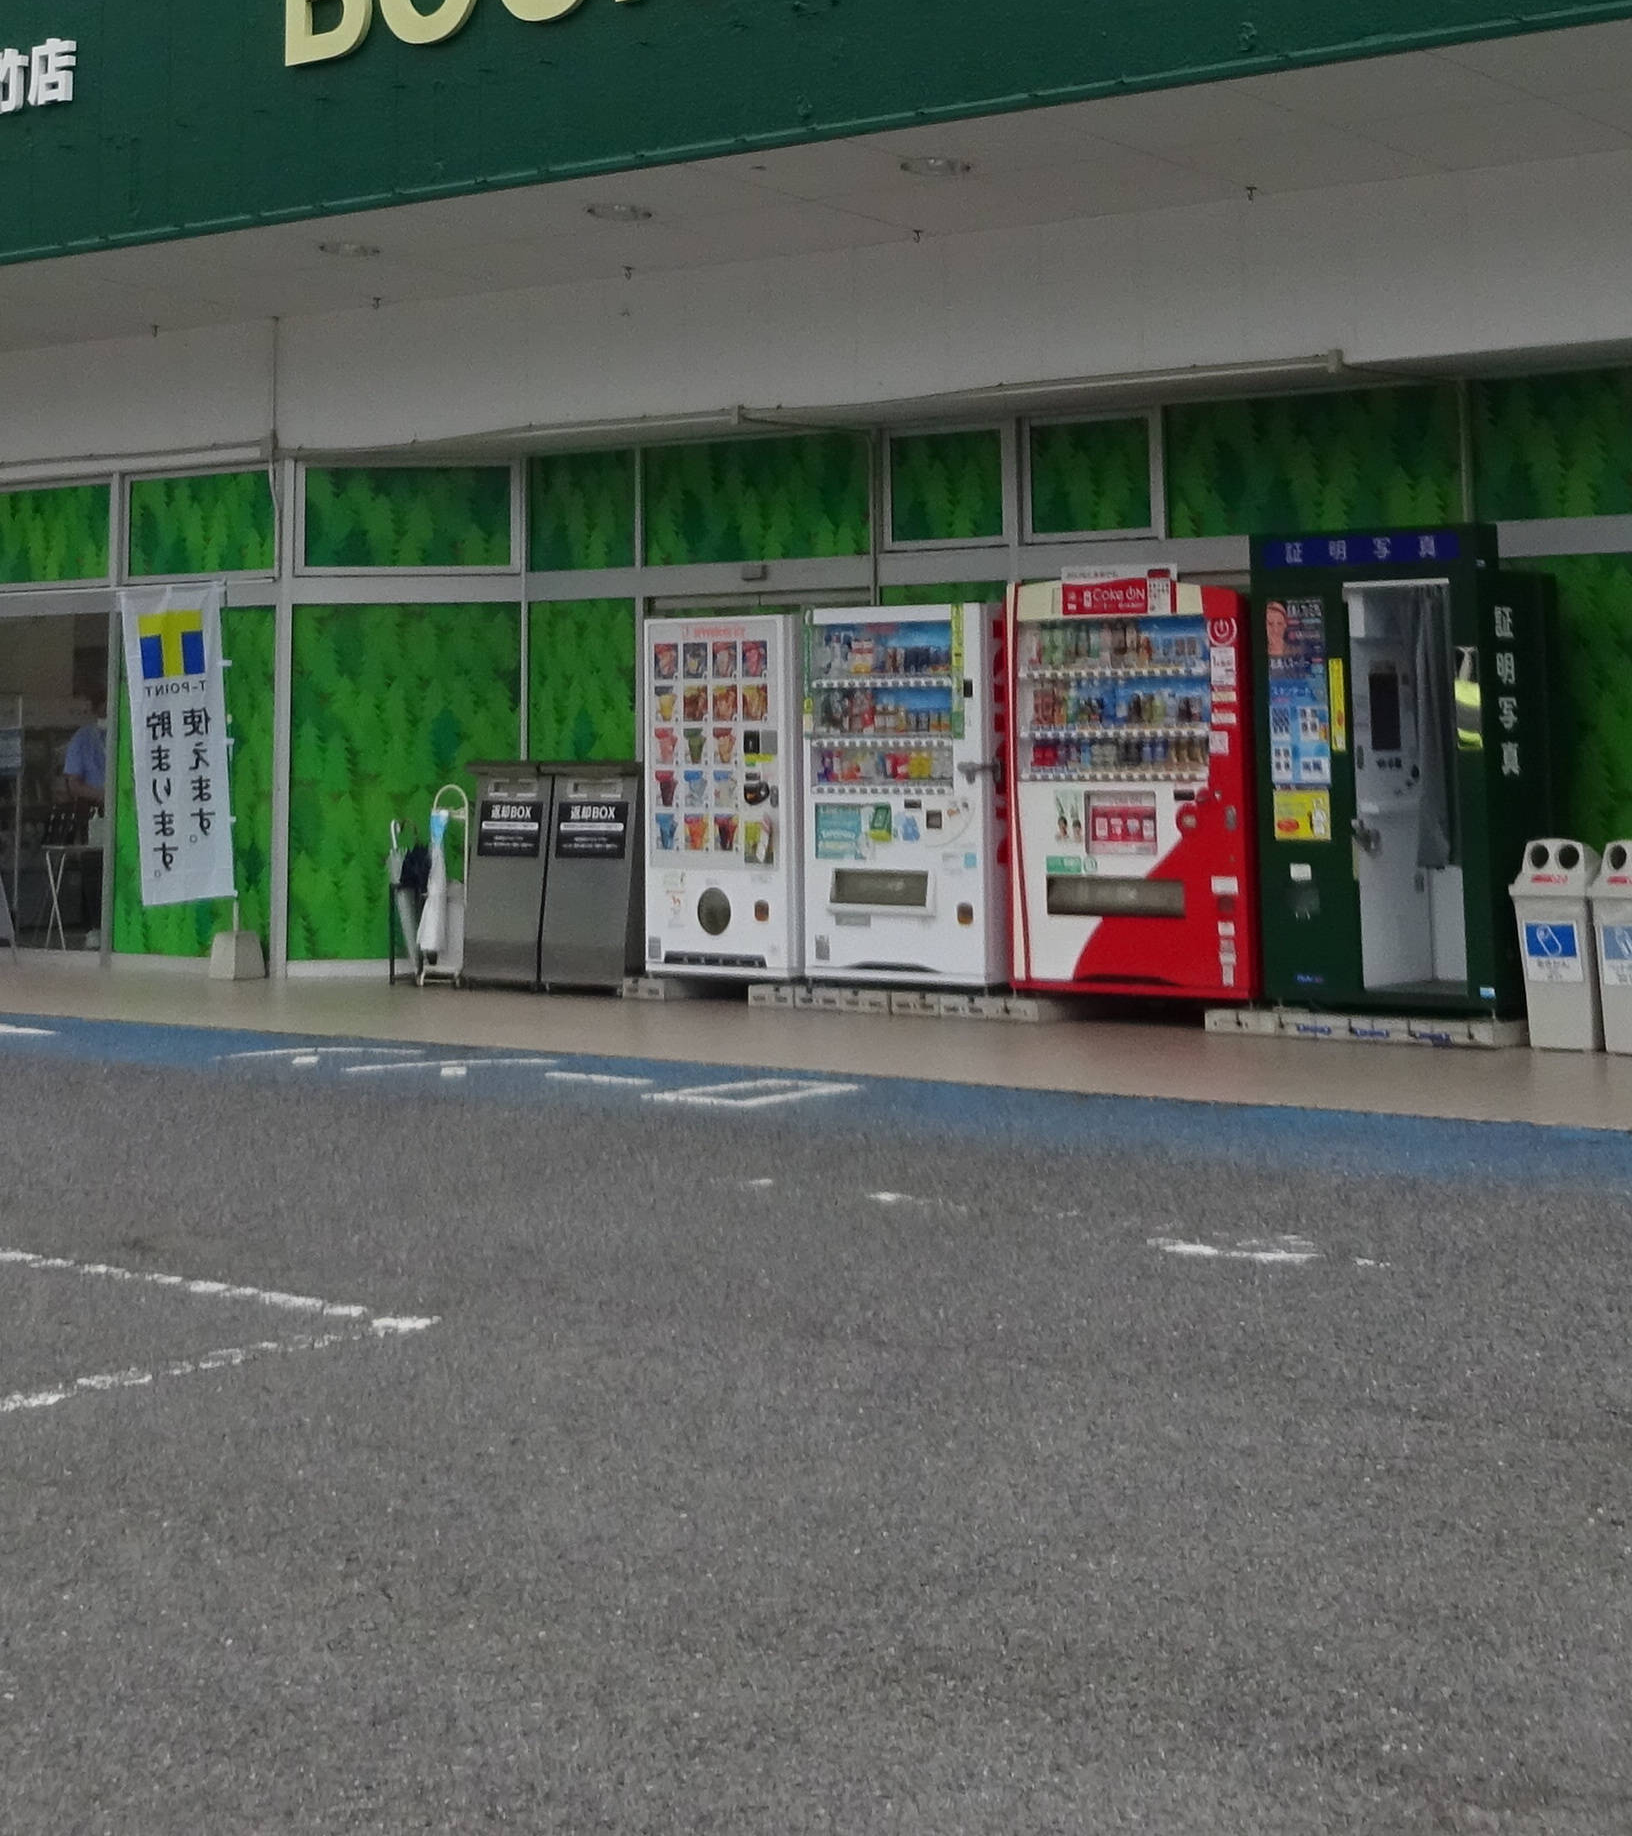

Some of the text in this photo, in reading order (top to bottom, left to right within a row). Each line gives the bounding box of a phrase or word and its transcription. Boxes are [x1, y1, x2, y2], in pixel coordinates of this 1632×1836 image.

[1284, 535, 1437, 565] 証明写真
[1493, 604, 1521, 777] 証明写真
[491, 804, 533, 820] 返却BOX
[570, 805, 616, 821] 返却BOX
